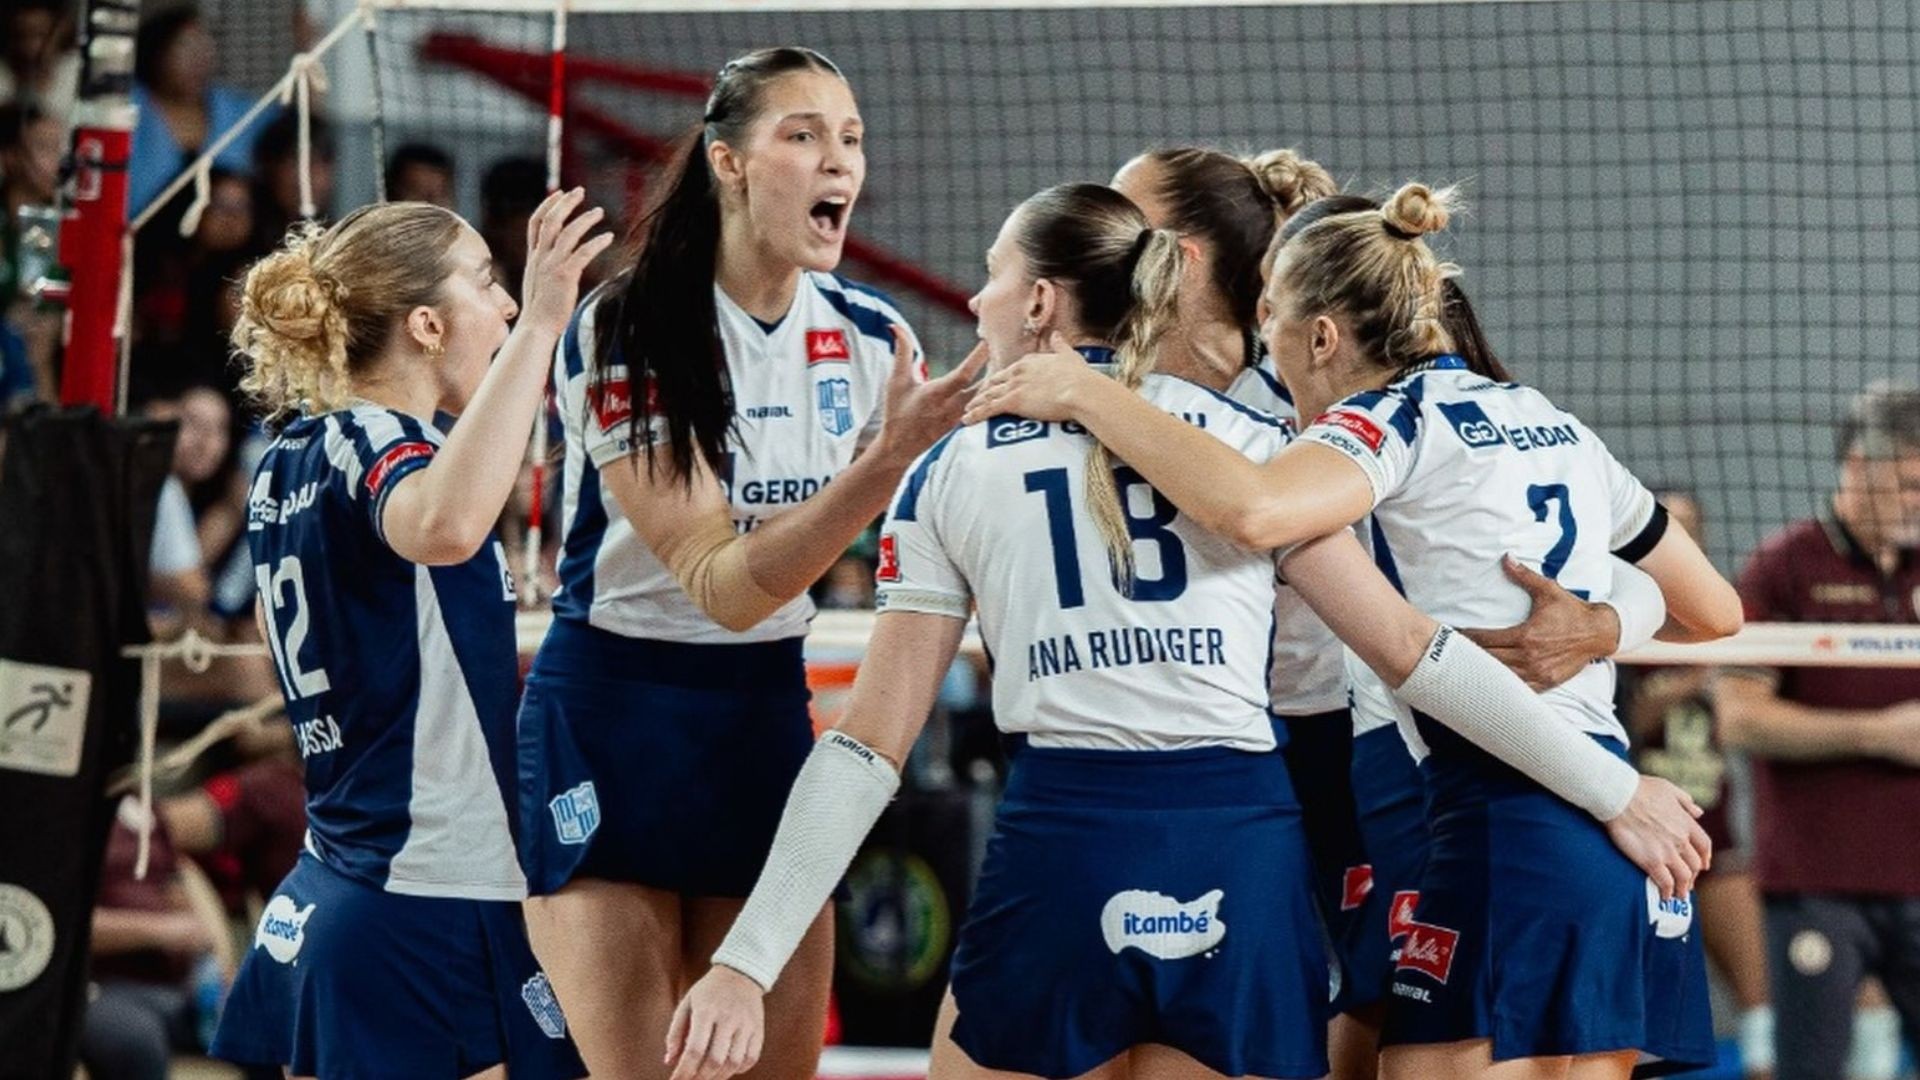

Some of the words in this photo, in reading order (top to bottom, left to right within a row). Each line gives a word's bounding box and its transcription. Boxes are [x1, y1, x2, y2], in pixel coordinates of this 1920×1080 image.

[1023, 466, 1188, 609] 18
[1527, 483, 1590, 602] 2
[255, 555, 331, 701] 12
[1028, 634, 1083, 683] ANA
[1088, 626, 1226, 669] RUDIGER
[293, 714, 344, 760] ASSA
[1123, 909, 1209, 936] itambé
